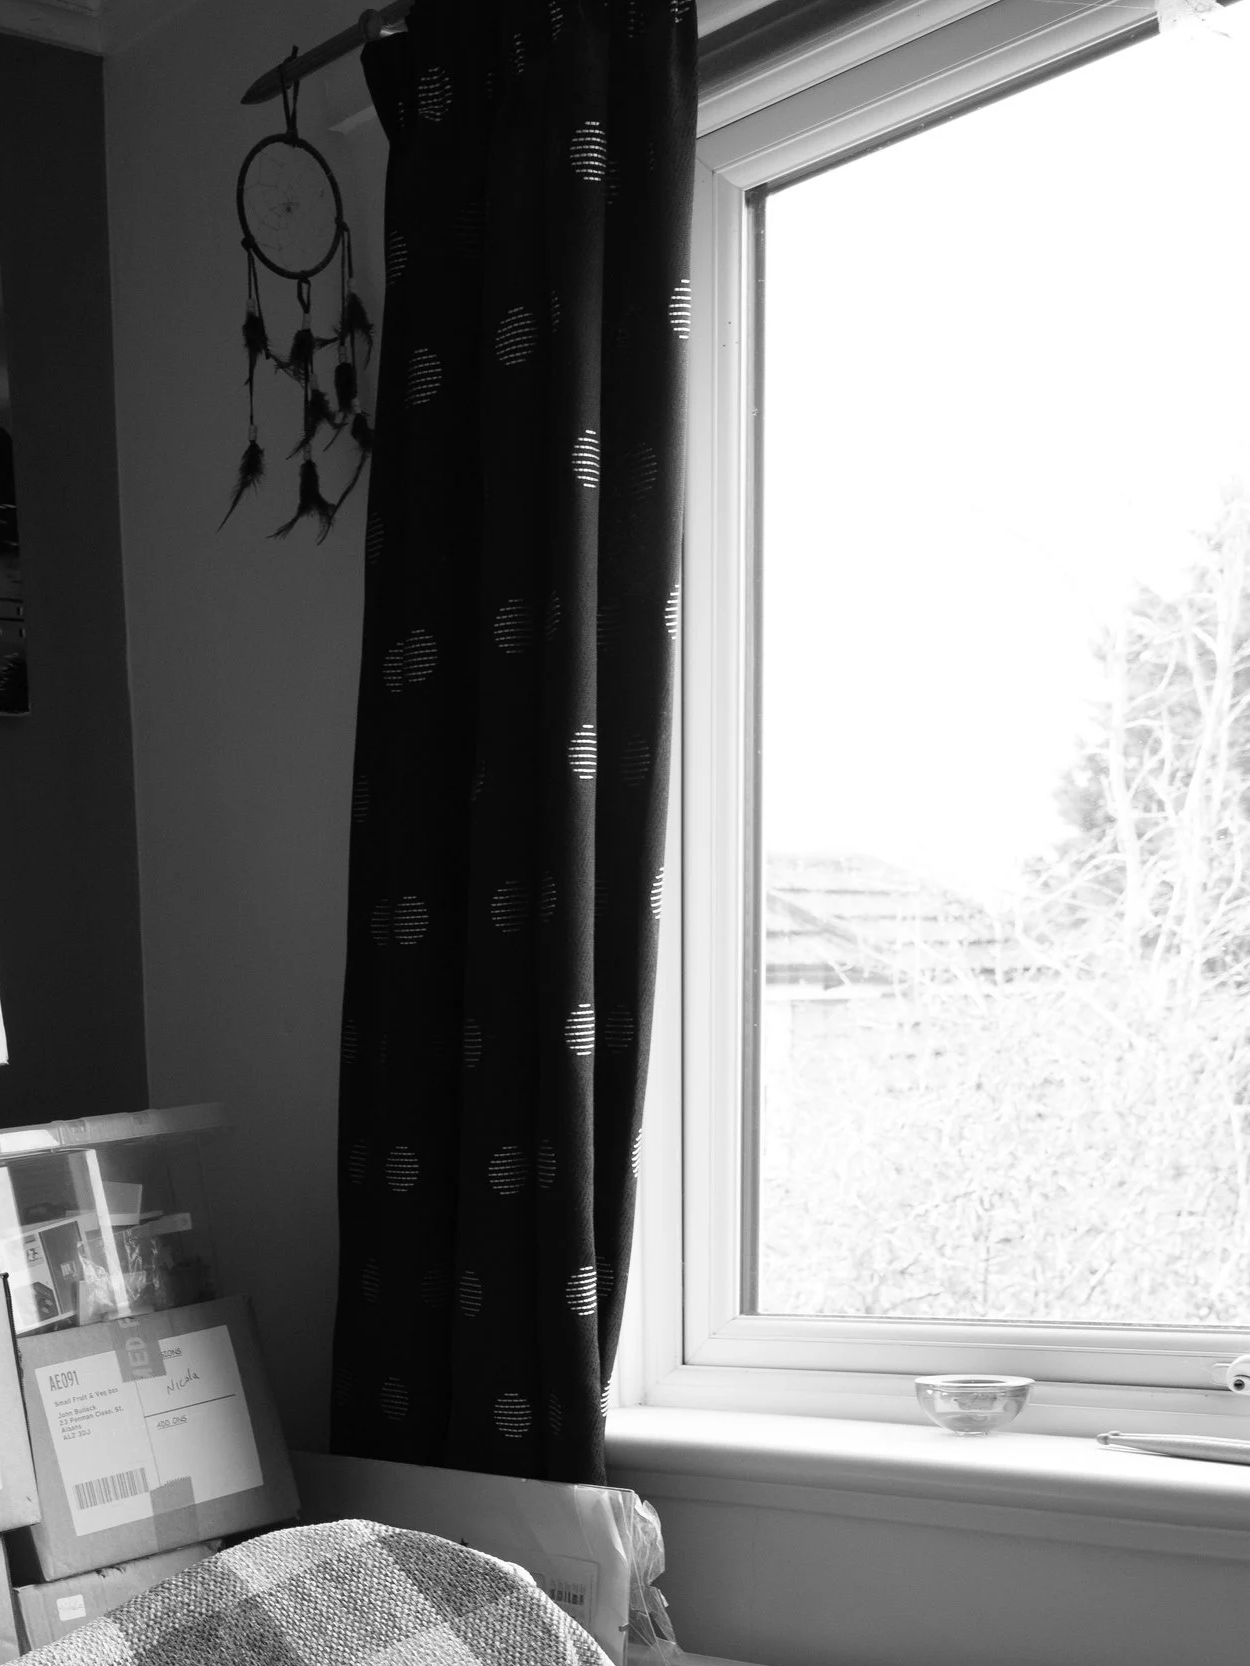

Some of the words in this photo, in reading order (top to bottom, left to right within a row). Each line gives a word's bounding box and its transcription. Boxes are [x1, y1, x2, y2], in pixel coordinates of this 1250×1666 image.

[48, 1370, 80, 1391] AE091
[166, 1368, 200, 1395] Nicola
[53, 1398, 71, 1408] Small
[72, 1394, 88, 1404] Fruit
[89, 1392, 94, 1400] &
[58, 1409, 73, 1419] John
[156, 1420, 170, 1429] ADD
[172, 1415, 188, 1424] ONS
